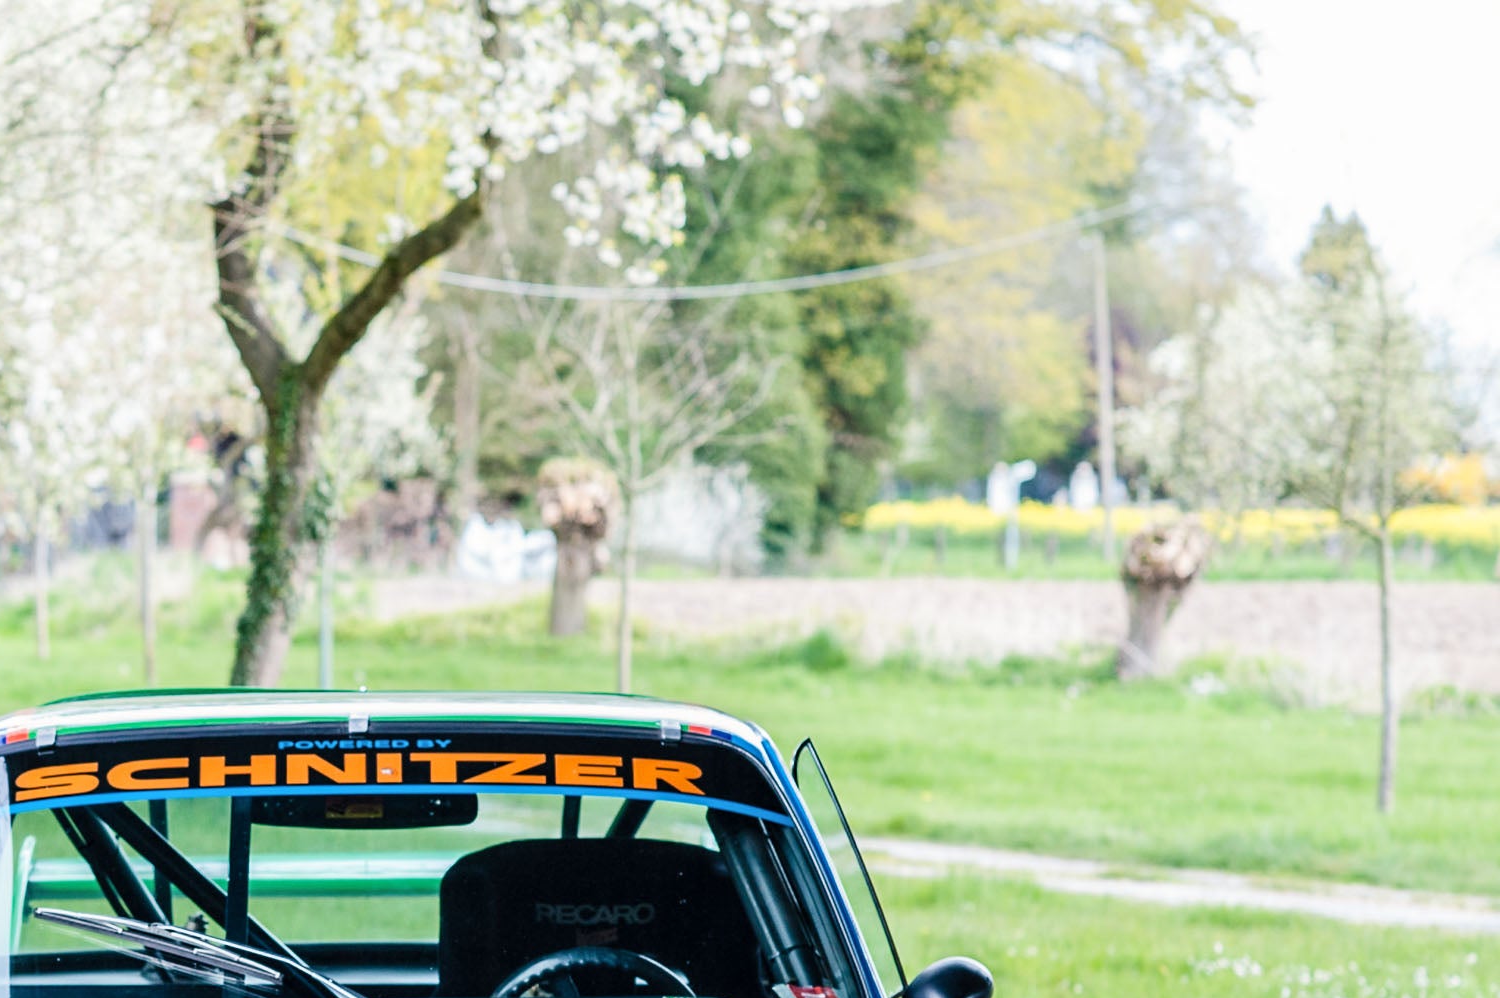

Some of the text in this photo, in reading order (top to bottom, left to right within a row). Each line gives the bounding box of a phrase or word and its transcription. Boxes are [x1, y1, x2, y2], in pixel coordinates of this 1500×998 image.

[278, 739, 451, 750] POWERED BY
[14, 753, 705, 801] SCHNITZER
[534, 902, 656, 925] RECARO
